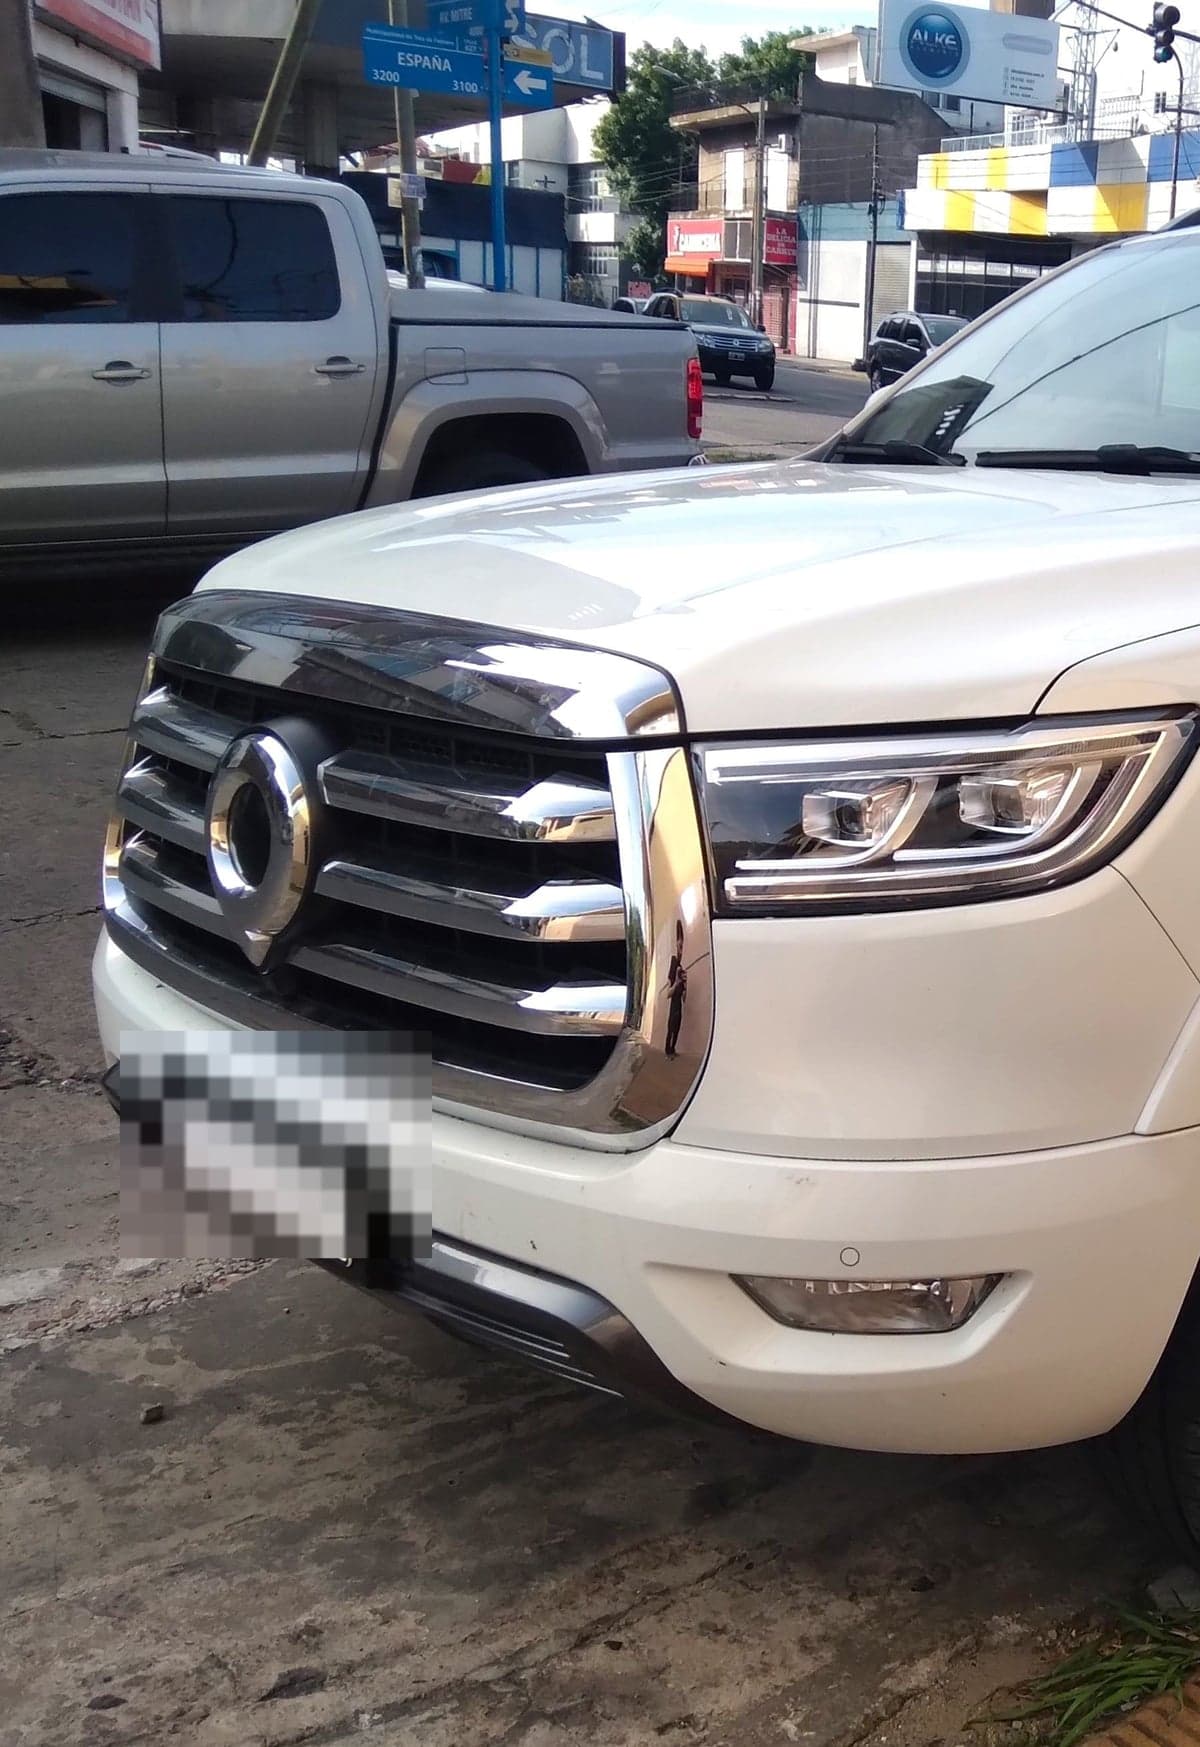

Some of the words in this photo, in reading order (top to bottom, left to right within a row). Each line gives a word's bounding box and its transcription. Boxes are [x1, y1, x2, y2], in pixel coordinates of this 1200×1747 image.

[451, 8, 472, 21] MITRE
[398, 52, 452, 72] ESPAÑA
[373, 69, 399, 82] 3200
[452, 80, 477, 93] 3100
